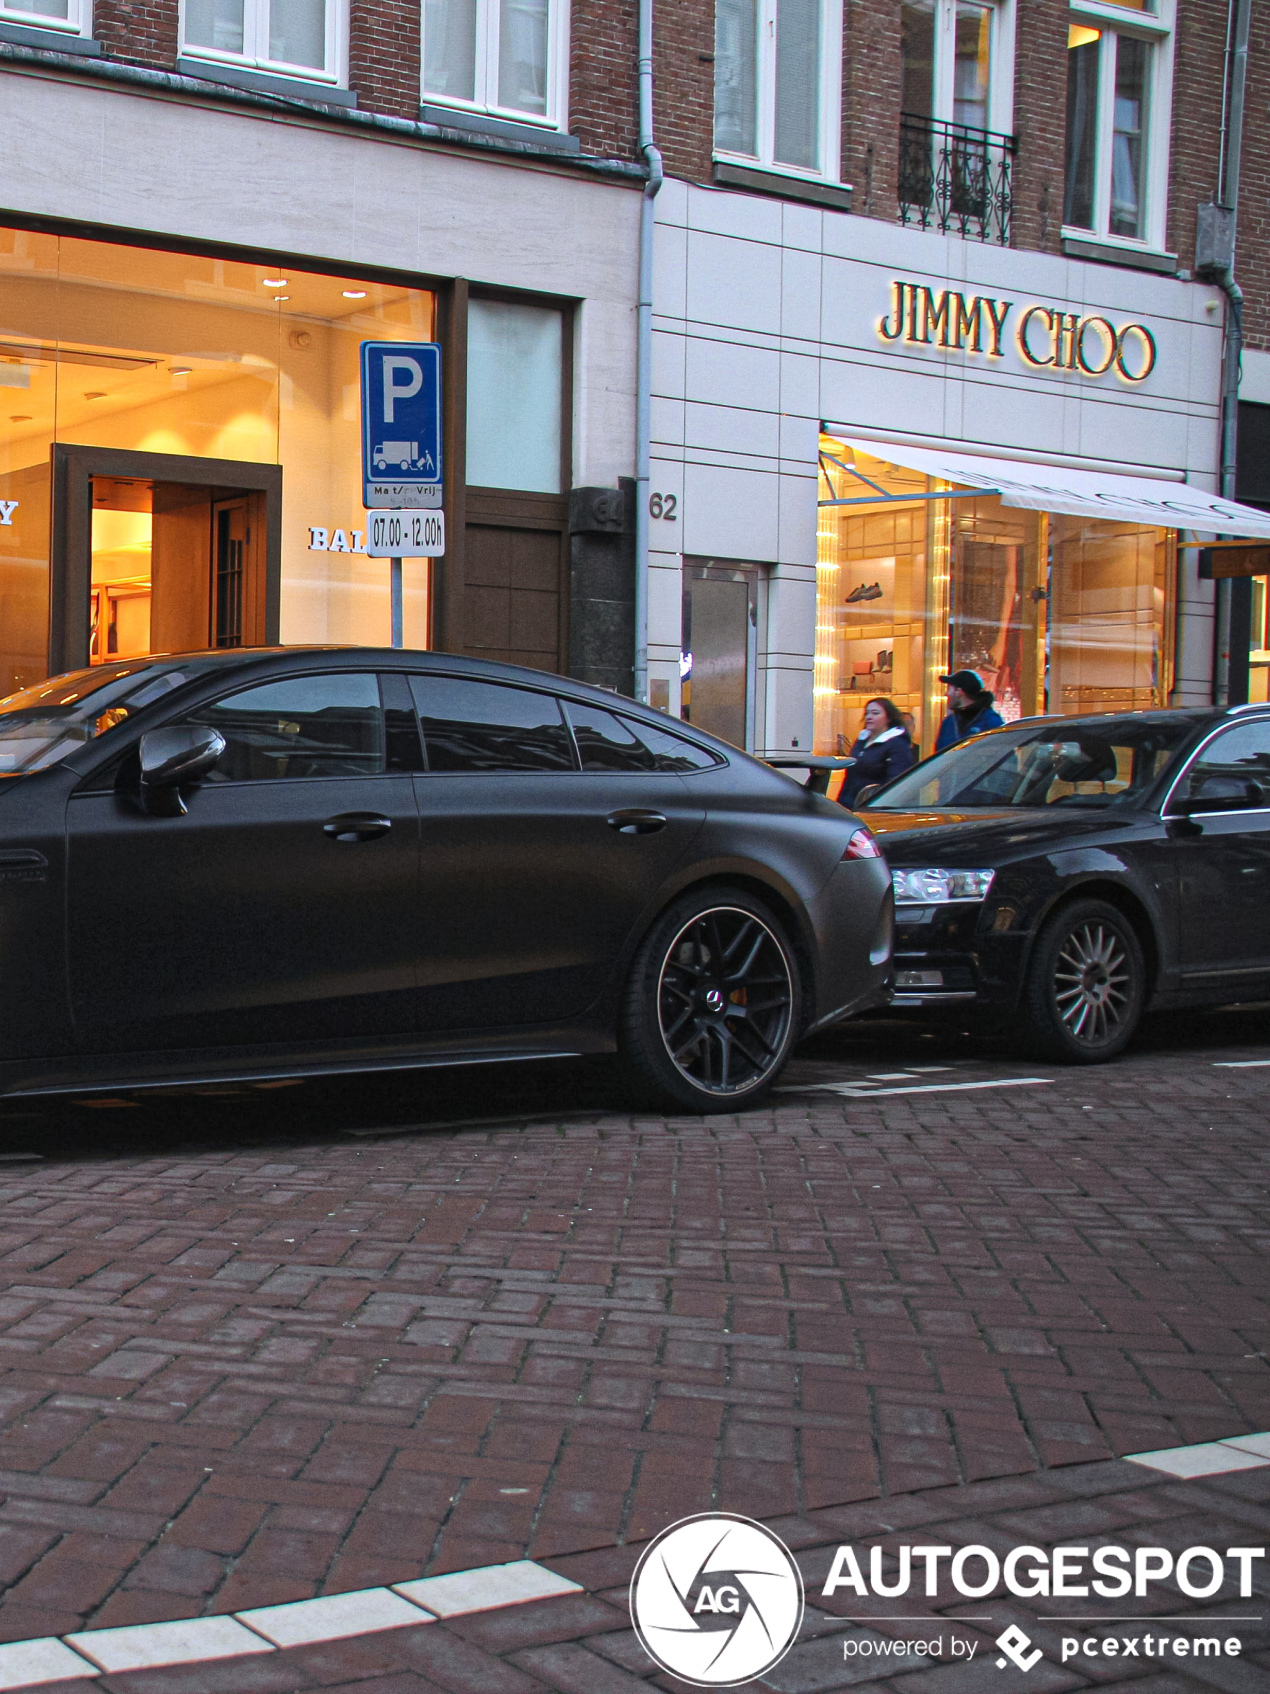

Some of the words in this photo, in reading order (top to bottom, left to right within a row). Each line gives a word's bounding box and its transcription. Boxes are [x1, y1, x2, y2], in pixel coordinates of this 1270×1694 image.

[879, 281, 1014, 357] JIMMY
[1017, 306, 1158, 381] CHOO
[382, 355, 423, 423] P
[374, 486, 389, 495] Ma
[417, 486, 436, 497] Vrij
[649, 492, 677, 521] 62
[308, 527, 368, 555] BAL
[373, 517, 401, 548] 07.00
[412, 517, 442, 547] 12.00h
